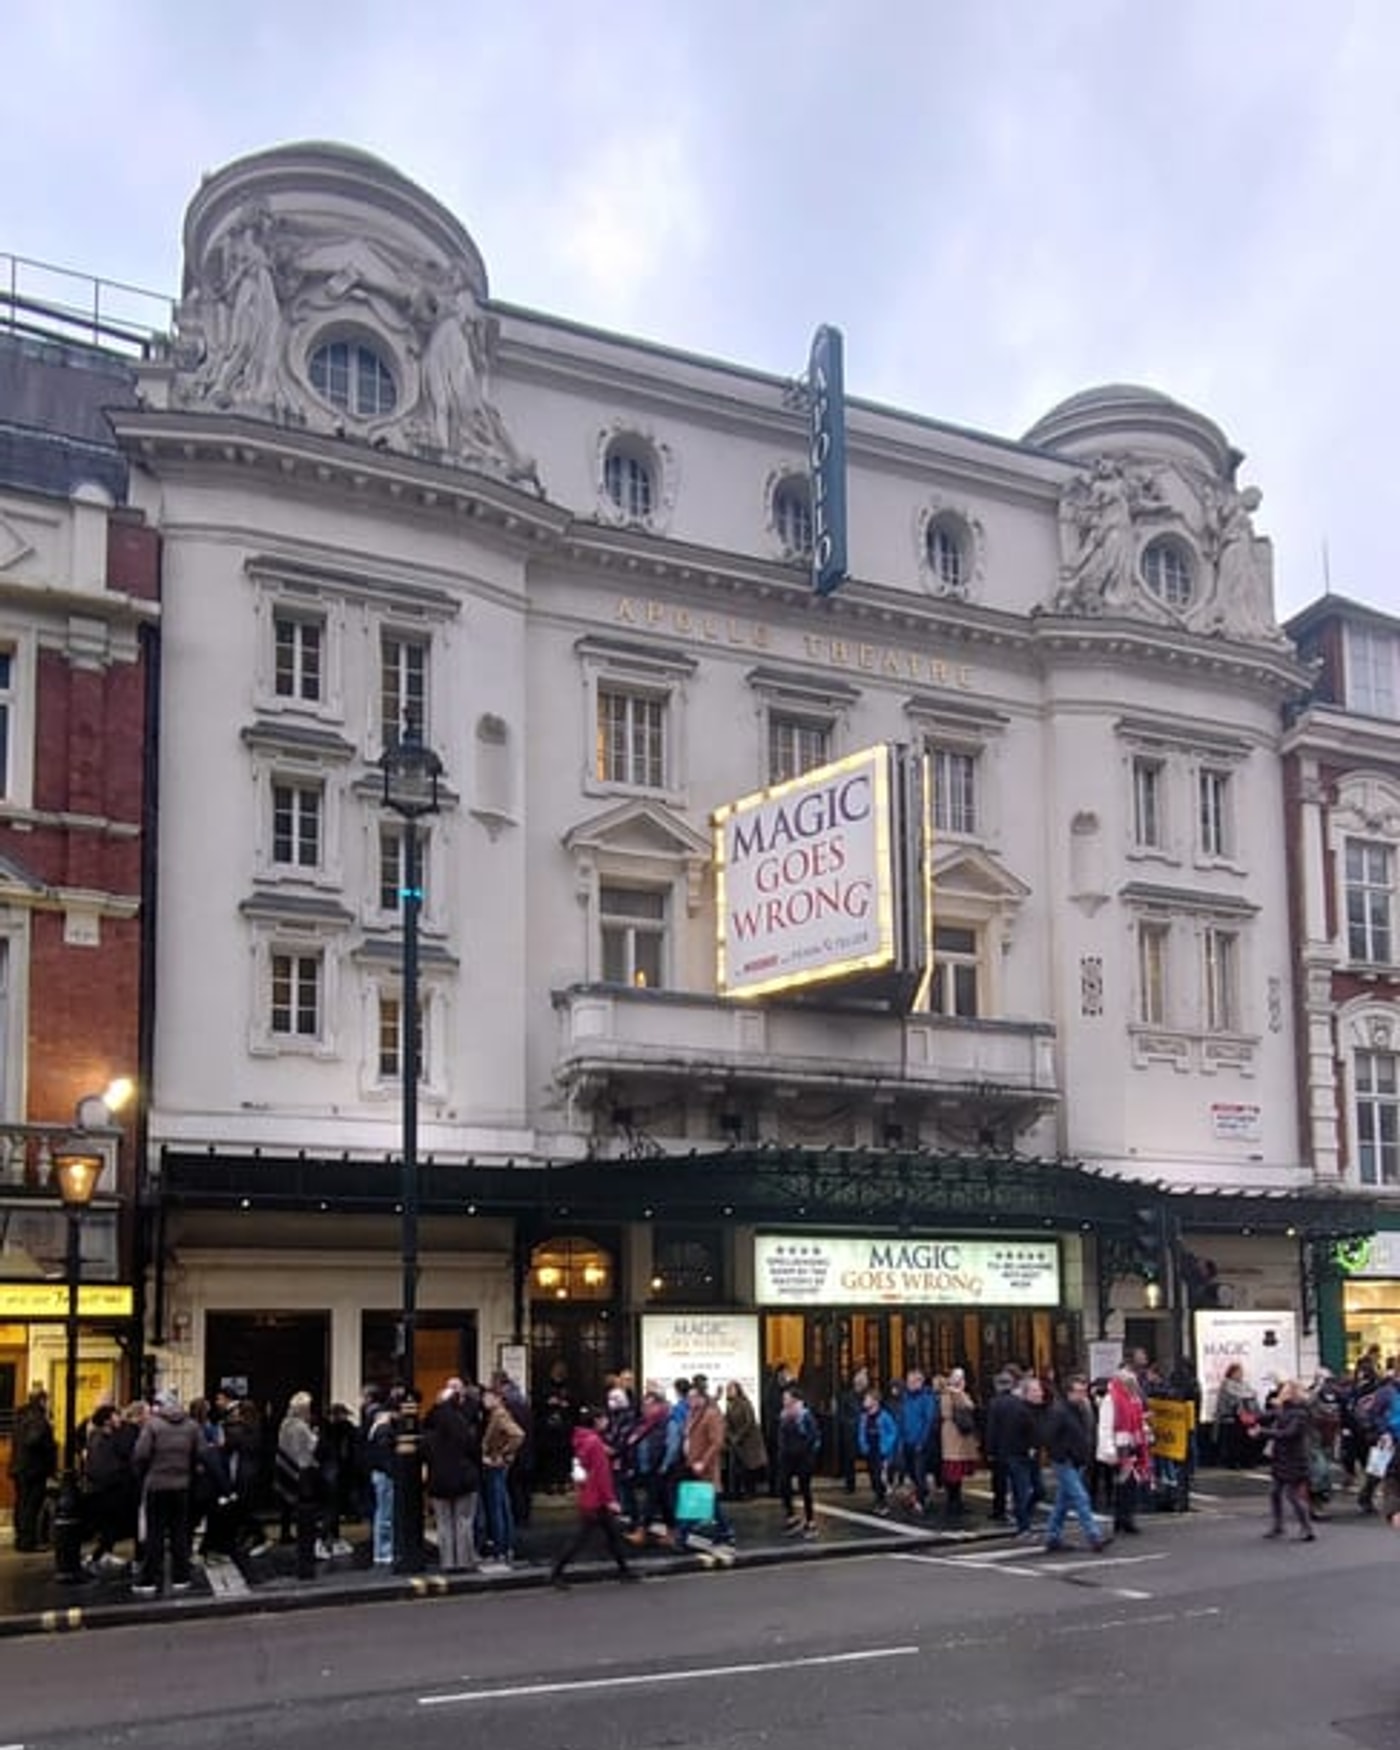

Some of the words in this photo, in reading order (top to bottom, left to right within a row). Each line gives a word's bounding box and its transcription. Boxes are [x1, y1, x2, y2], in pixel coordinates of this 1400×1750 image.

[803, 634, 977, 688] THEATRE
[731, 776, 871, 864] MAGIC
[756, 835, 845, 893] GOES
[732, 879, 872, 942] WRONG
[840, 1270, 896, 1291] GOES
[901, 1271, 984, 1298] WRONG
[869, 1244, 960, 1270] MAGIC
[1204, 1341, 1250, 1356] MAGIC
